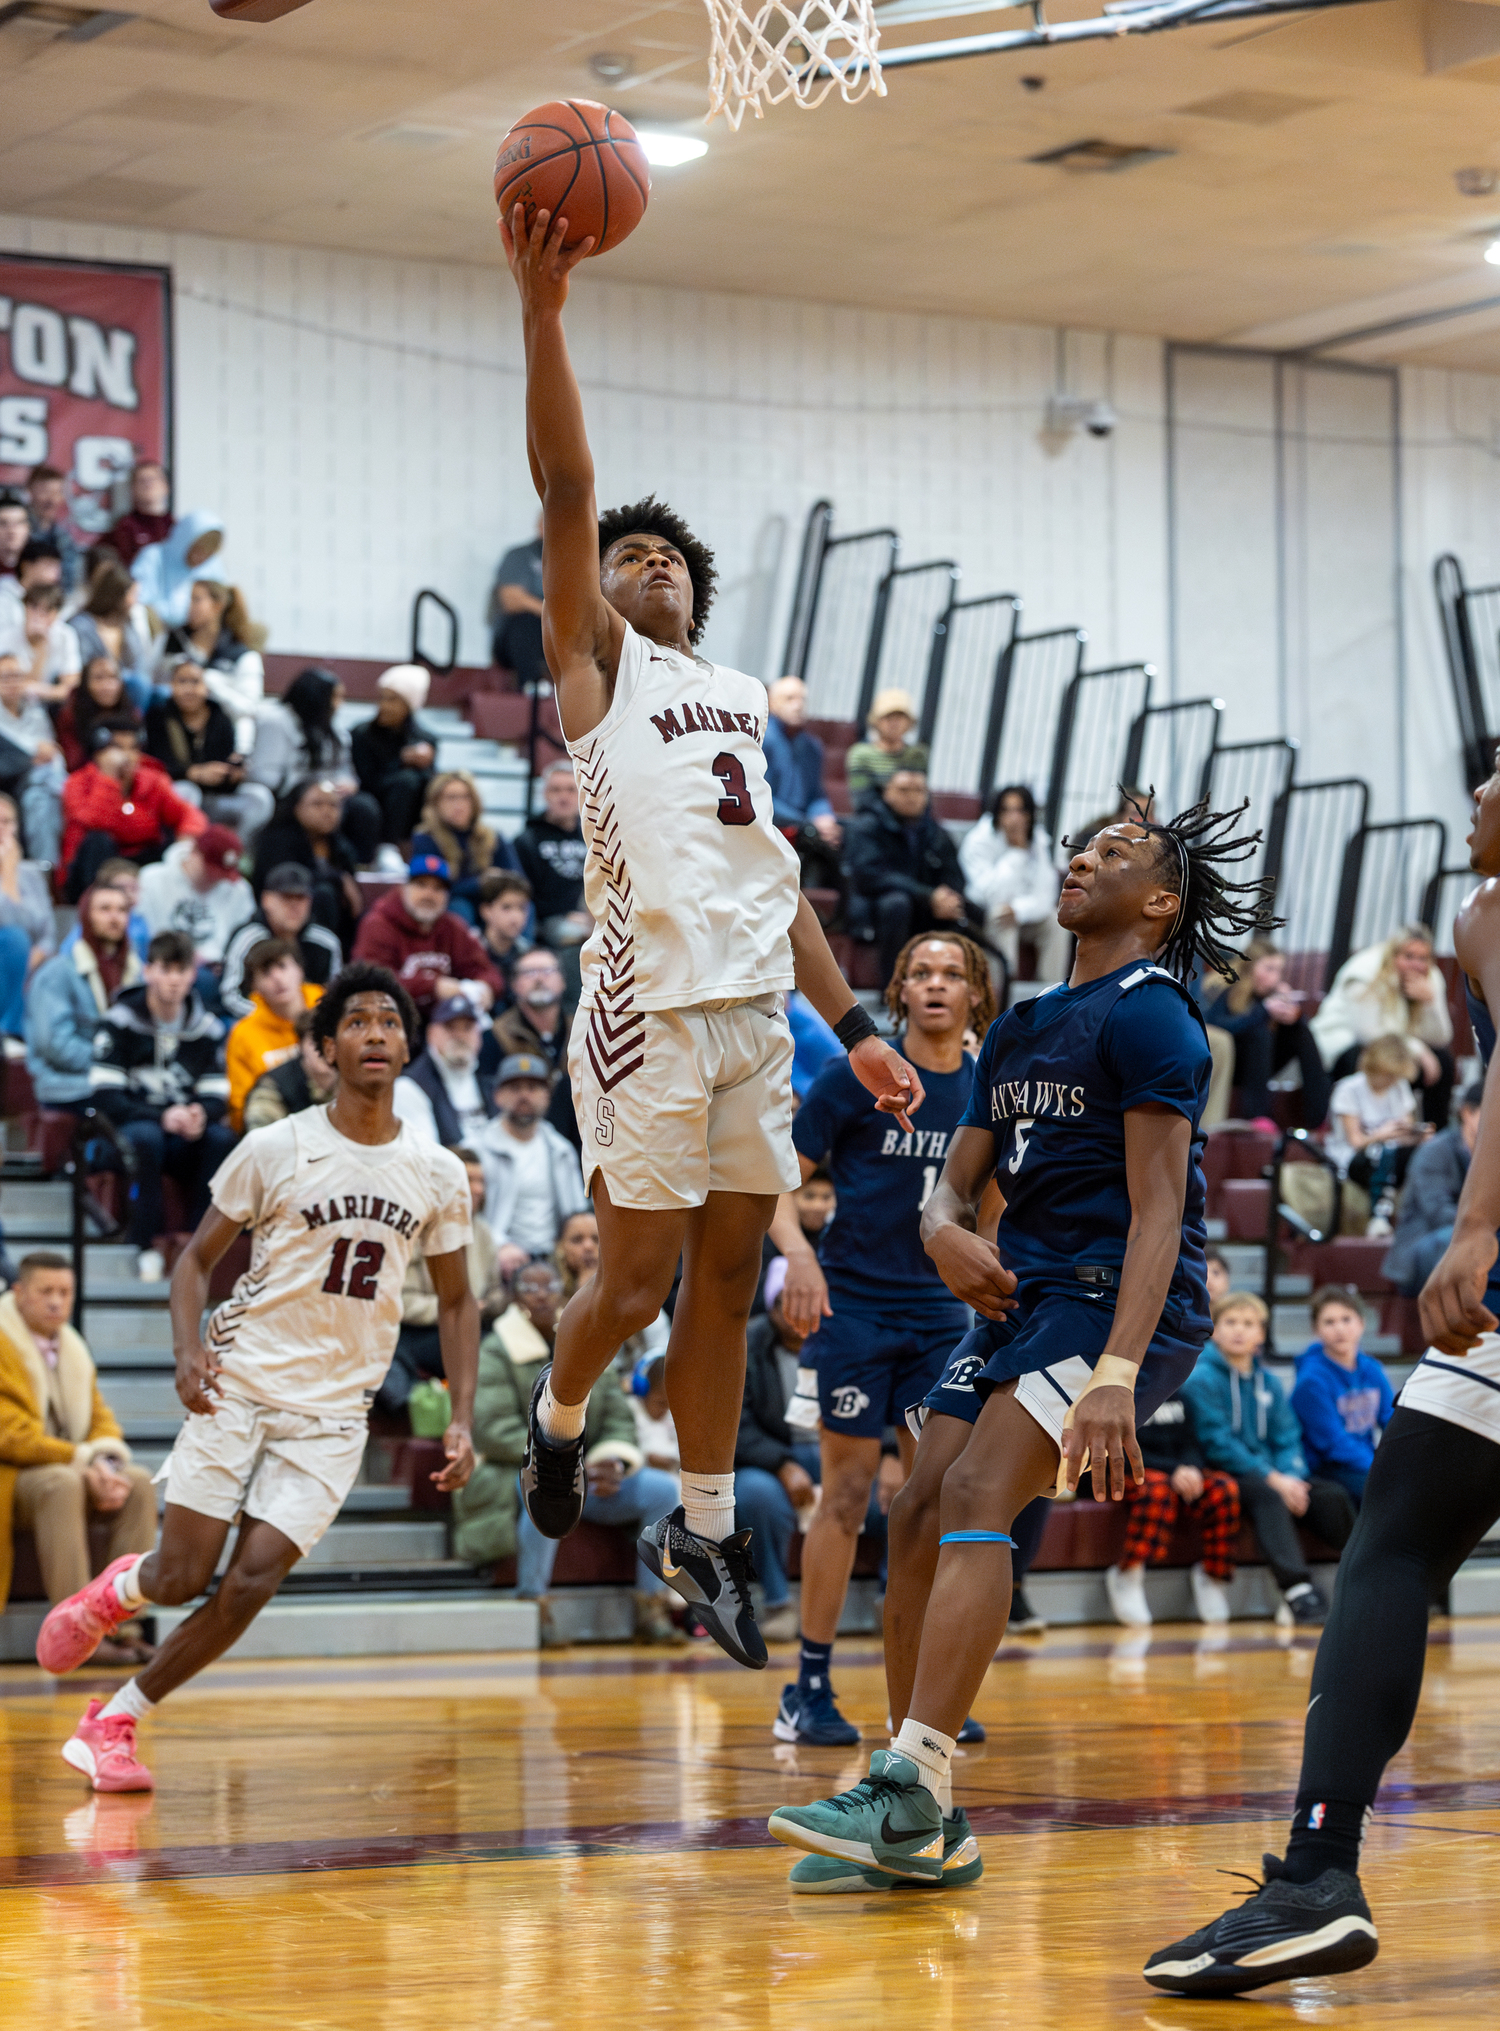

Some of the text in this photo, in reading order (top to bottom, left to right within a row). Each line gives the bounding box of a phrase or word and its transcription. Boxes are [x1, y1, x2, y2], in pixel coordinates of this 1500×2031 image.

[0, 295, 139, 412] ON
[711, 751, 757, 826] 3
[595, 1096, 615, 1148] S
[1008, 1118, 1036, 1175] 5
[322, 1237, 386, 1301] 12
